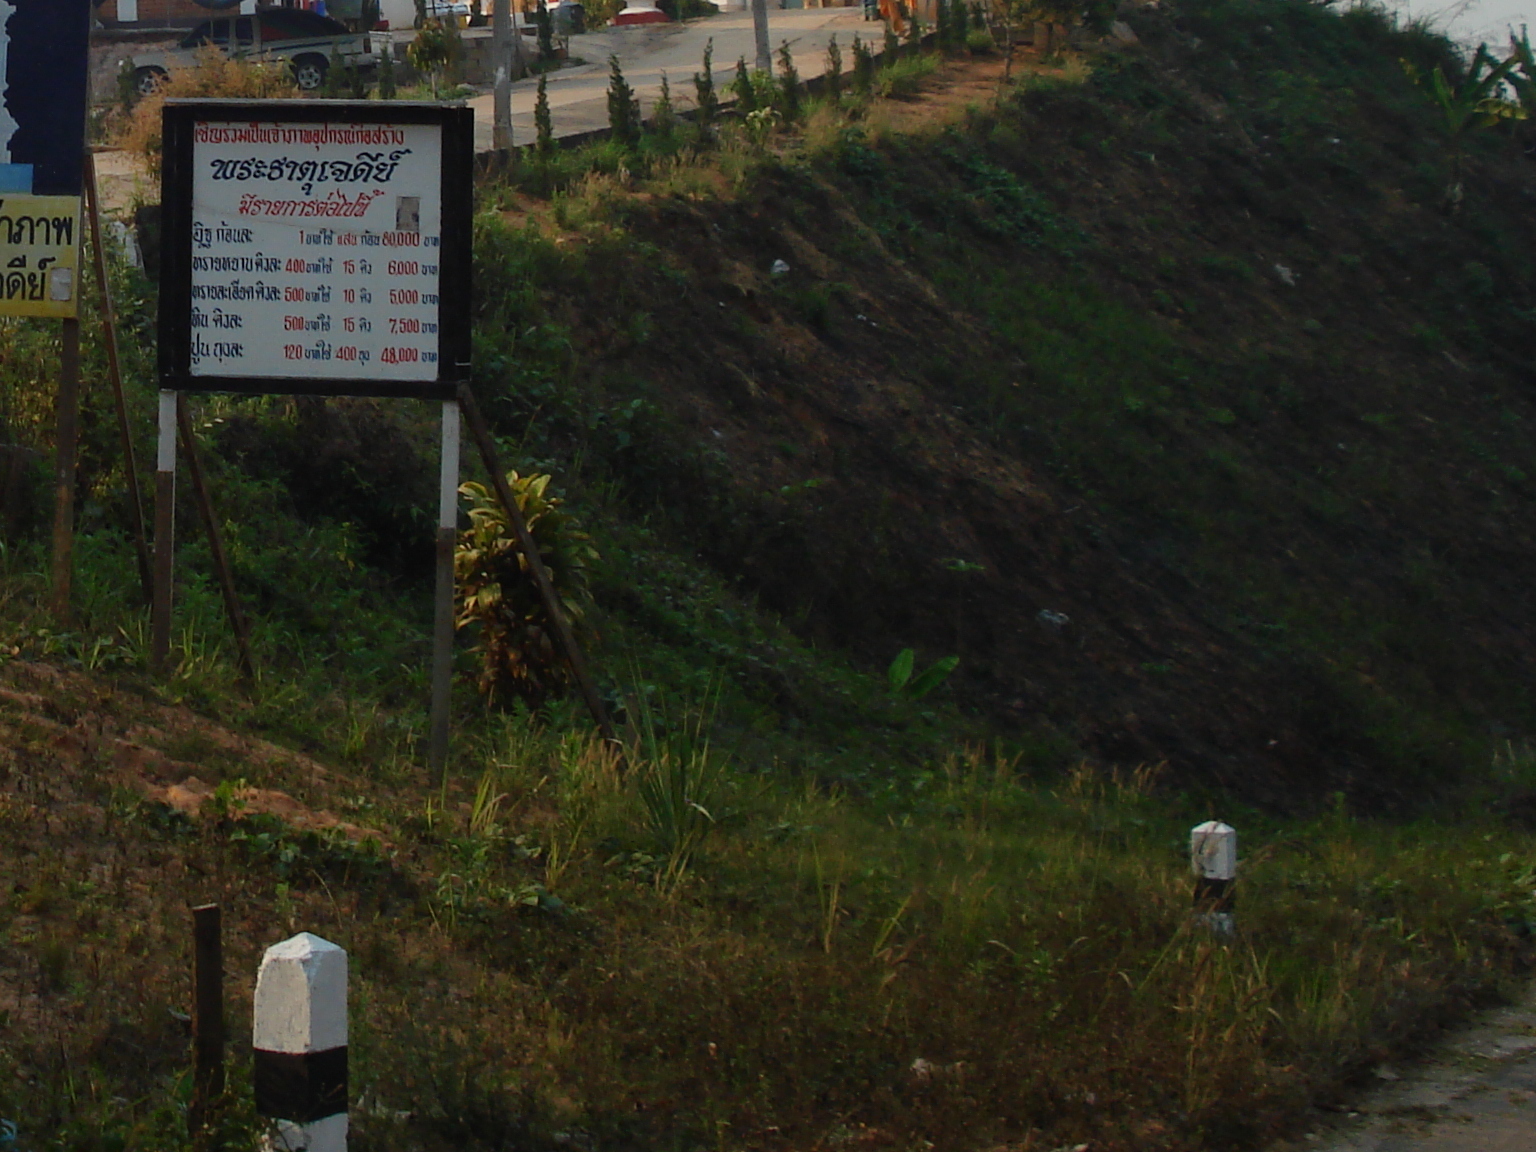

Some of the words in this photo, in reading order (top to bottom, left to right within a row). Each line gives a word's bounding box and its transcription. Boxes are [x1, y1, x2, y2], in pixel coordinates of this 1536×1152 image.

[210, 148, 413, 195] พระธาตุเจดีย์
[343, 260, 355, 274] 15
[343, 288, 355, 303] 10
[343, 317, 355, 332] 15
